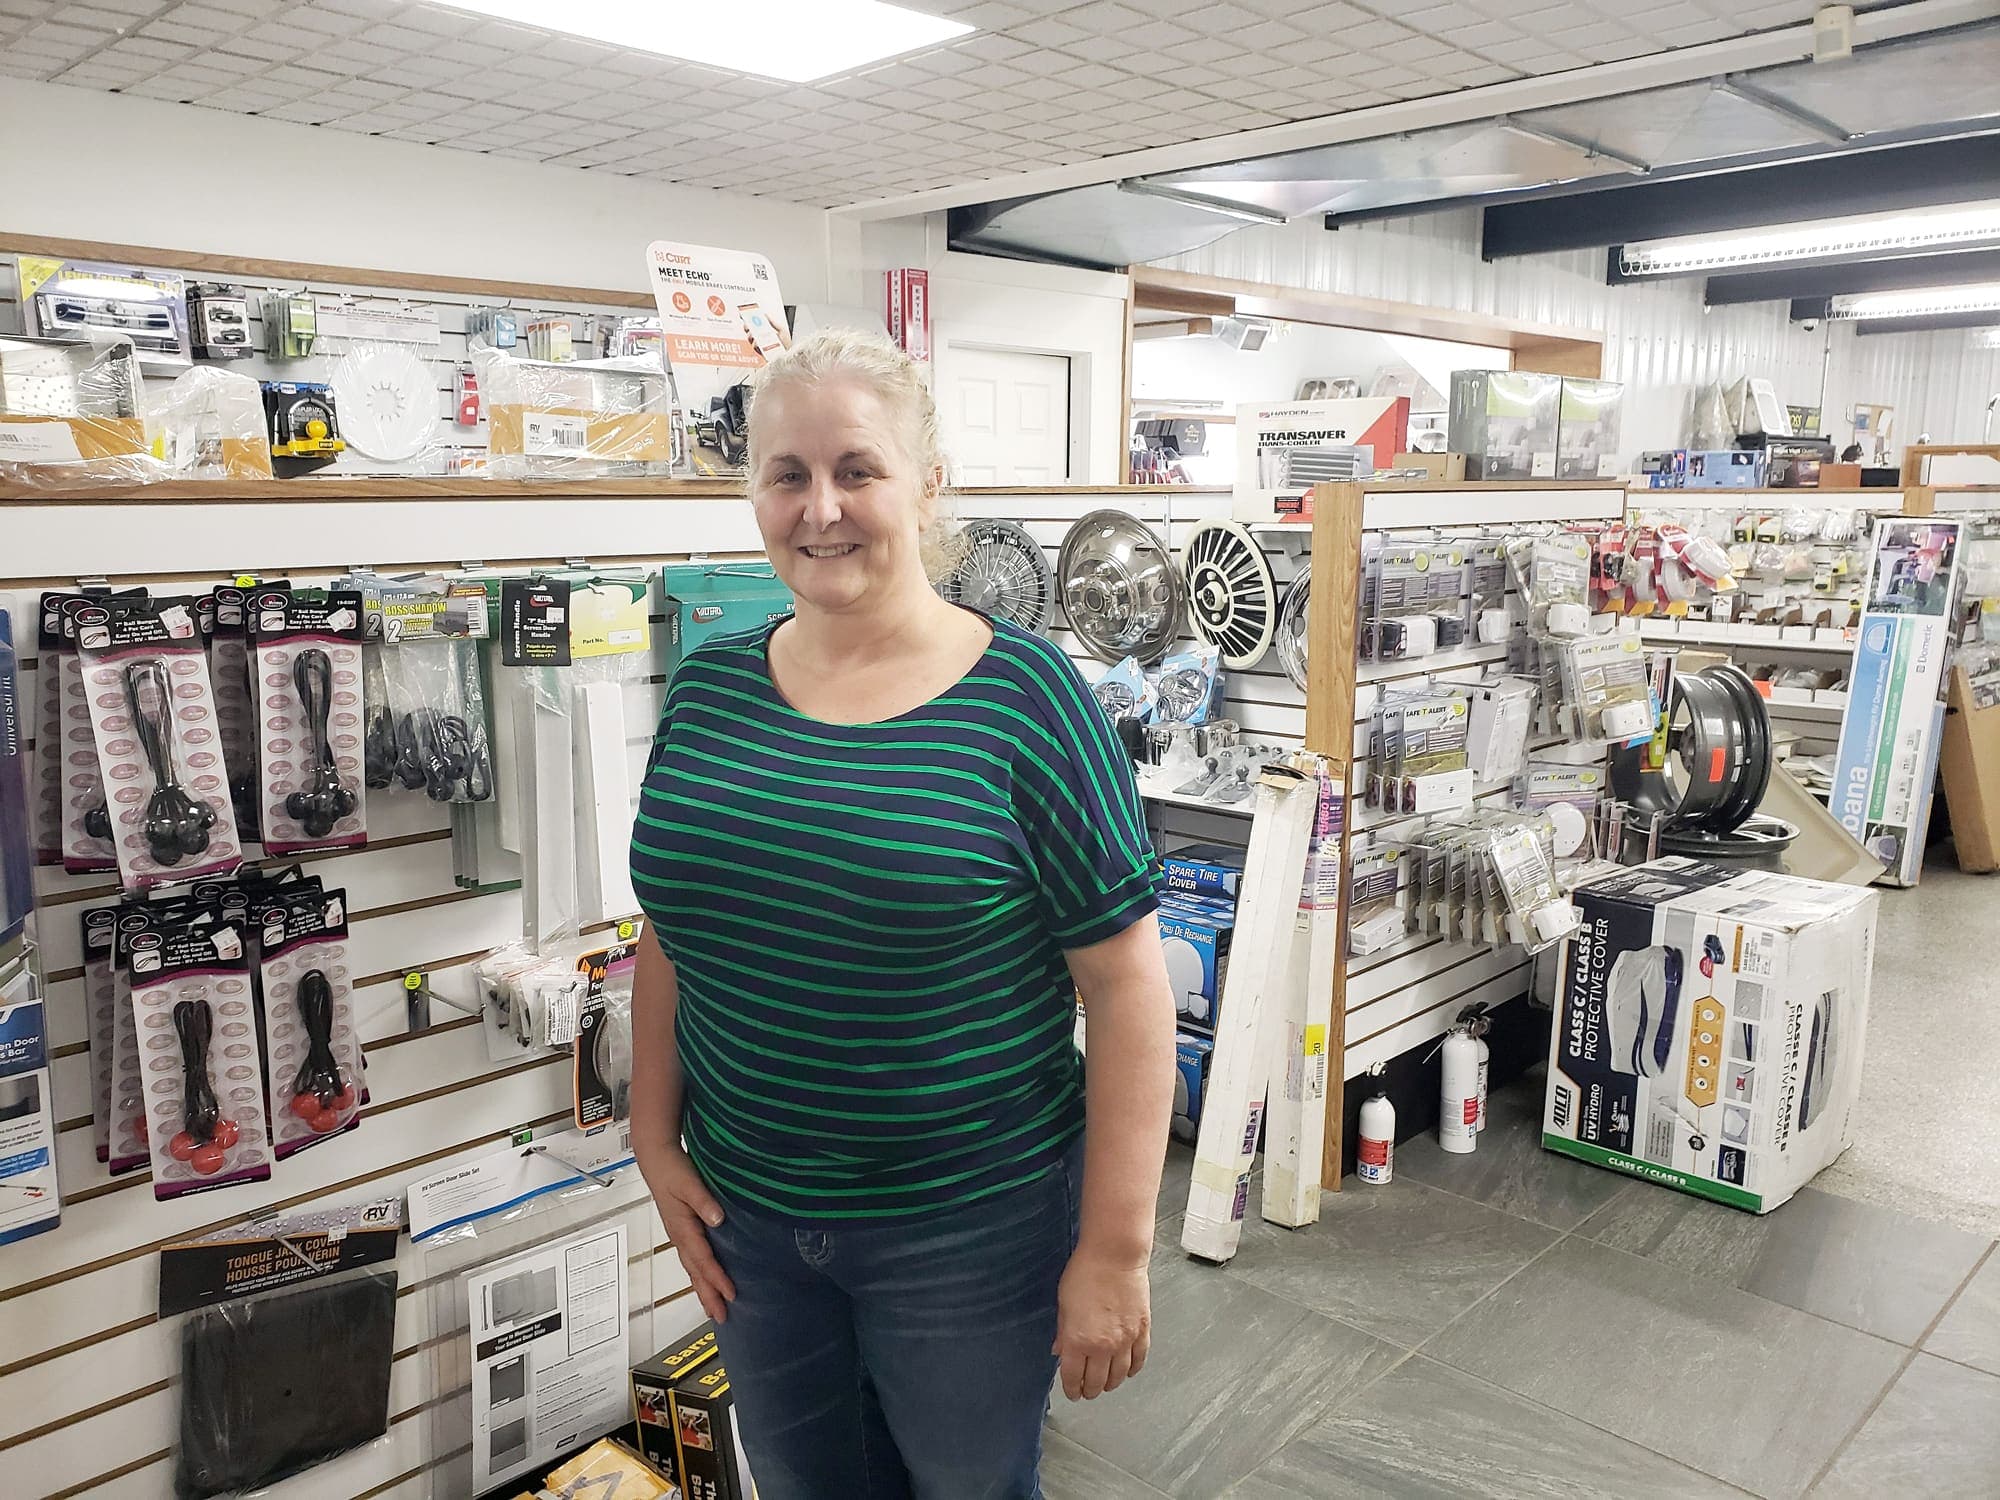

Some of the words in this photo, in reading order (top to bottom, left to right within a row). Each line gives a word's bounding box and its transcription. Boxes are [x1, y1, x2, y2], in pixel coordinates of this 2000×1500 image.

[666, 252, 691, 264] CURT
[658, 267, 682, 279] MEET
[686, 270, 710, 281] ECHO
[686, 280, 705, 288] MOBILE
[724, 283, 756, 292] CONTROLLER
[675, 338, 709, 352] LEARN
[711, 342, 741, 354] MORE!
[1258, 430, 1346, 442] TRANSAVER
[385, 604, 408, 616] BOSS
[409, 602, 448, 614] SHADOW
[367, 614, 380, 637] 2
[388, 620, 401, 643] 2
[1918, 624, 1933, 663] Dometic
[1406, 709, 1420, 717] SAFE
[1428, 706, 1446, 714] ALERT
[1168, 864, 1196, 878] SPARE
[1200, 868, 1218, 882] TIRE
[1168, 876, 1197, 890] COVER
[1175, 926, 1183, 936] DE
[1184, 928, 1214, 944] RECHANGE
[1581, 922, 1593, 934] B
[1592, 918, 1608, 969] COVER
[1576, 935, 1591, 984] CLASS
[1574, 985, 1587, 995] /
[1574, 995, 1586, 1007] C
[1584, 970, 1604, 1061] PROTECTIVE
[1570, 1009, 1585, 1057] CLASS
[1792, 1003, 1803, 1058] CLASSE
[14, 1036, 40, 1048] Door
[1314, 1042, 1321, 1055] 20
[1782, 1005, 1796, 1094] PROTECTIVE
[8, 1048, 26, 1057] Bar
[1790, 1062, 1798, 1072] C
[1552, 1084, 1568, 1132] ADCO
[1589, 1084, 1600, 1121] HYDRO
[1775, 1097, 1786, 1145] COVER
[1782, 1086, 1795, 1140] CLASSE
[1587, 1121, 1597, 1140] UV
[1608, 1157, 1635, 1171] CLASS
[1650, 1170, 1678, 1184] CLASS
[1679, 1178, 1687, 1186] B
[429, 1180, 445, 1189] Screen
[367, 1204, 389, 1220] RV
[226, 1263, 273, 1282] HOUSSE
[309, 1246, 340, 1262] VÉRIN
[227, 1250, 273, 1270] TONGUE
[275, 1243, 302, 1259] JAK
